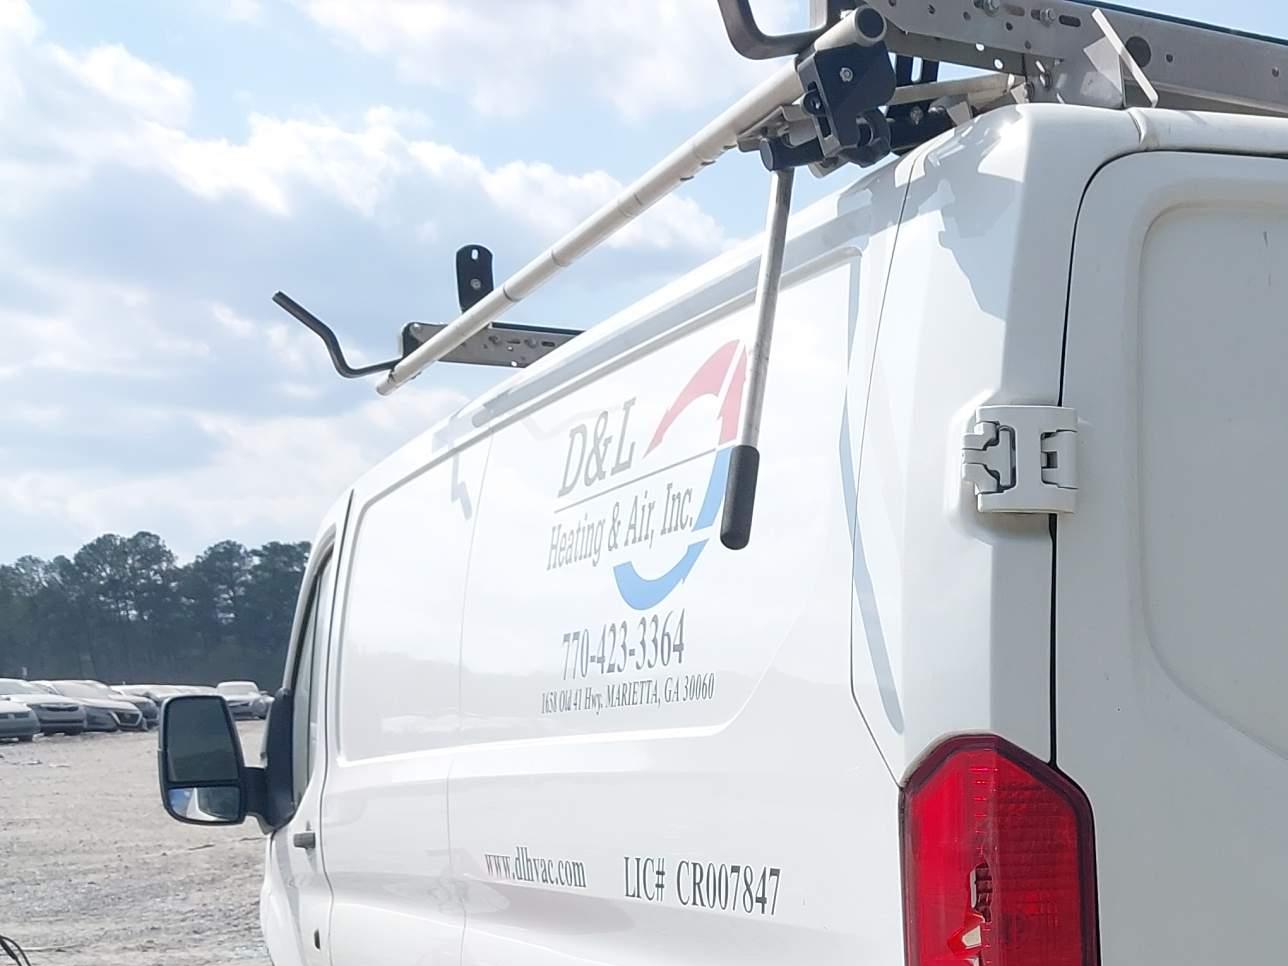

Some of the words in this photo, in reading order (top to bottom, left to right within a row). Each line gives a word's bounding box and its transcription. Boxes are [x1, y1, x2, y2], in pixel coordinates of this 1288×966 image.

[557, 397, 637, 498] D&L
[547, 513, 605, 571] Heating
[608, 499, 621, 551] &
[624, 490, 654, 548] Air,
[661, 483, 694, 536] Inc.
[562, 608, 686, 681] 770-423-3364
[559, 690, 571, 712] Old
[573, 688, 582, 711] 41
[584, 687, 603, 715] Hwy.
[605, 680, 660, 708] MARIETTA,
[664, 677, 679, 703] GA
[683, 673, 715, 701] 30060
[484, 847, 586, 888] www.dlhvac.com
[624, 856, 665, 902] LIC#
[676, 860, 780, 915] CR007847
